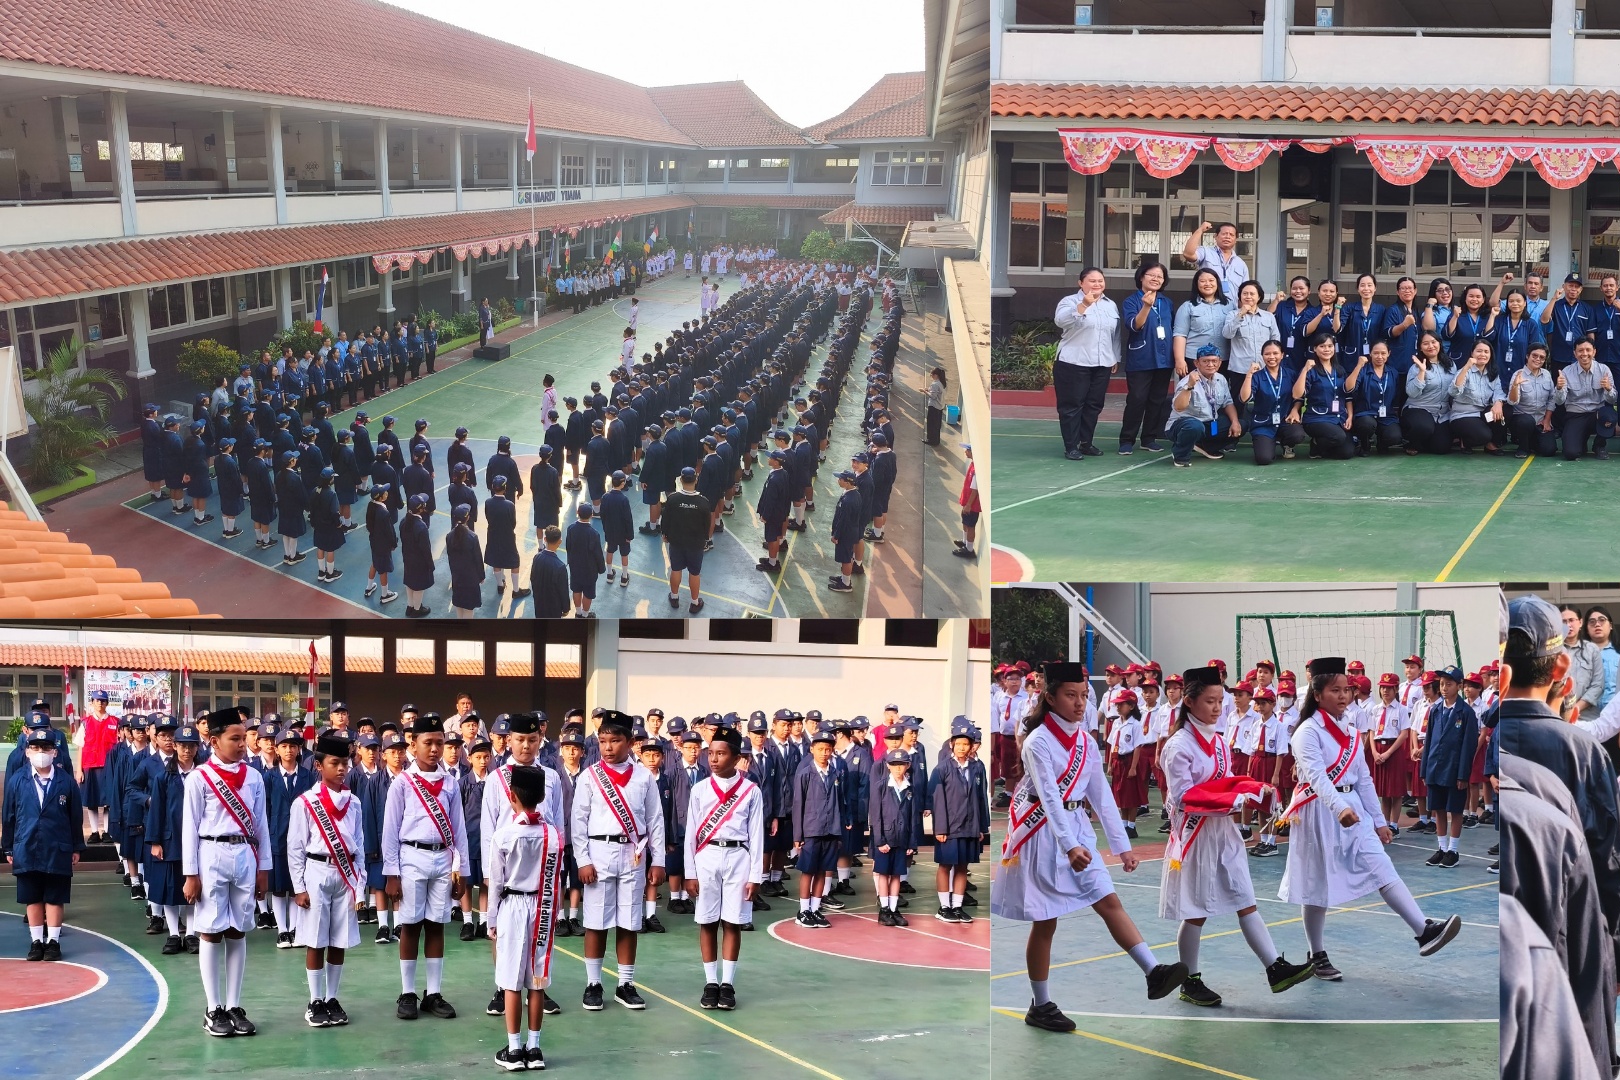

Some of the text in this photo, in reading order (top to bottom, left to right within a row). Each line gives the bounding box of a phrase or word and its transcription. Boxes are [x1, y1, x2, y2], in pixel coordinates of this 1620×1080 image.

[1062, 744, 1084, 787] BENDERA
[215, 779, 248, 821] PEMIMPIN
[593, 763, 635, 834] PEMIMPIN BARISAN
[710, 793, 739, 824] BARISAN
[312, 799, 353, 878] PEMIMPIN BARISAN
[537, 852, 557, 947] PEMIMPIN UPACARA
